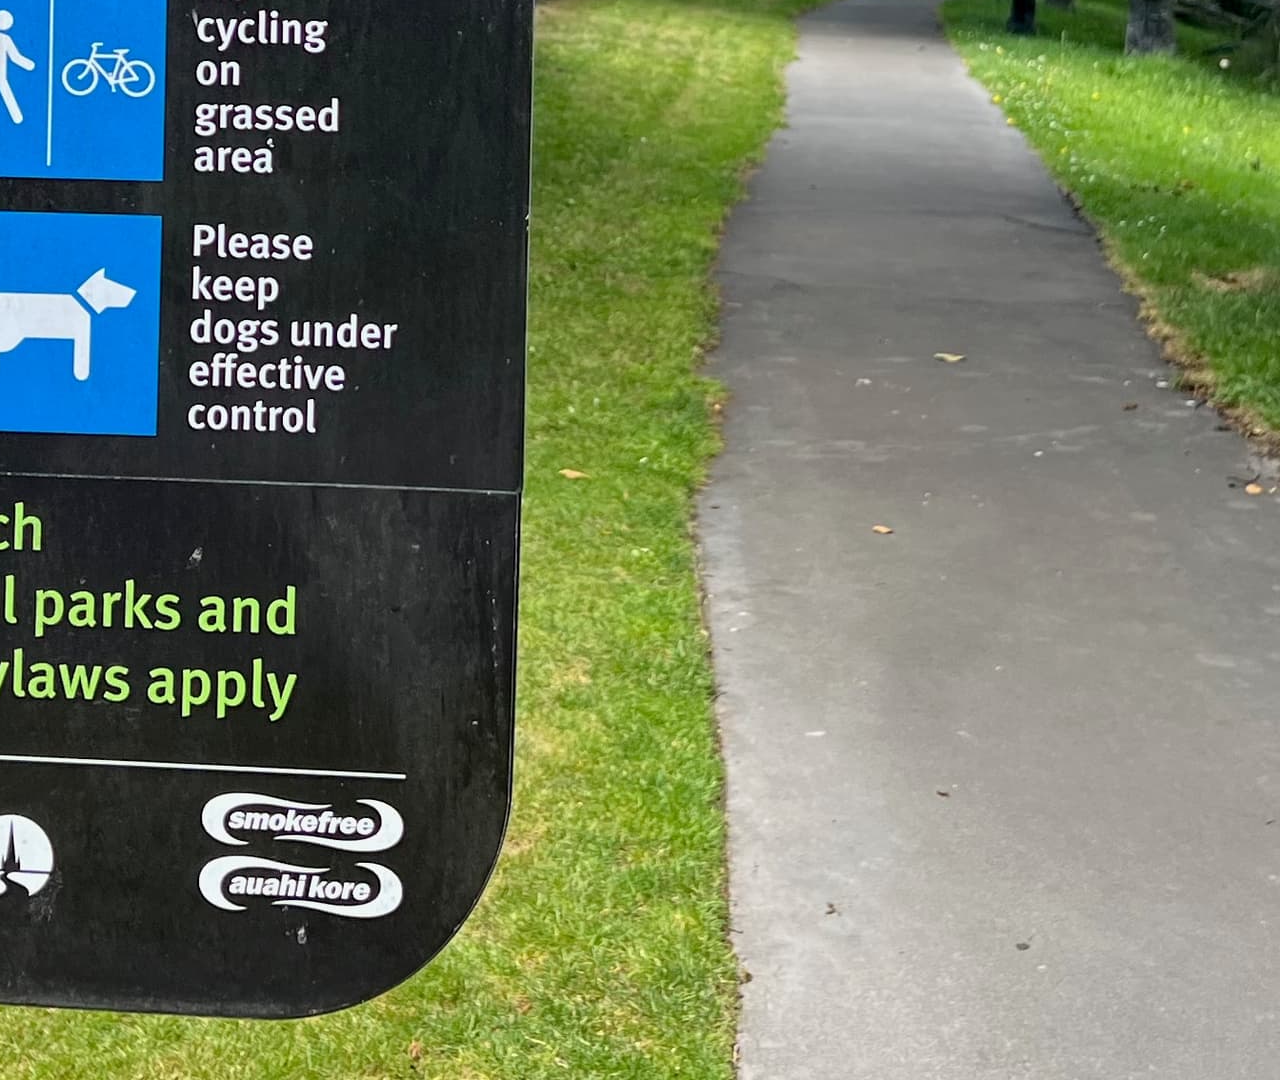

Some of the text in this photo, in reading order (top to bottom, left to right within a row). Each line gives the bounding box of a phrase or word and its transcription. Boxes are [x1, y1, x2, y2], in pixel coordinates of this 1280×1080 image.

[197, 10, 328, 53] cycling
[197, 61, 239, 85] on
[195, 98, 338, 135] grassed
[195, 145, 274, 173] area
[194, 224, 312, 260] Please
[192, 266, 278, 310] keep
[191, 309, 397, 352] dogs under
[190, 353, 345, 390] effective
[188, 399, 316, 433] control
[35, 580, 180, 637] parks
[199, 586, 295, 634] and
[148, 659, 296, 721] apply
[228, 809, 374, 836] smokefree
[228, 874, 371, 901] auahi kore
